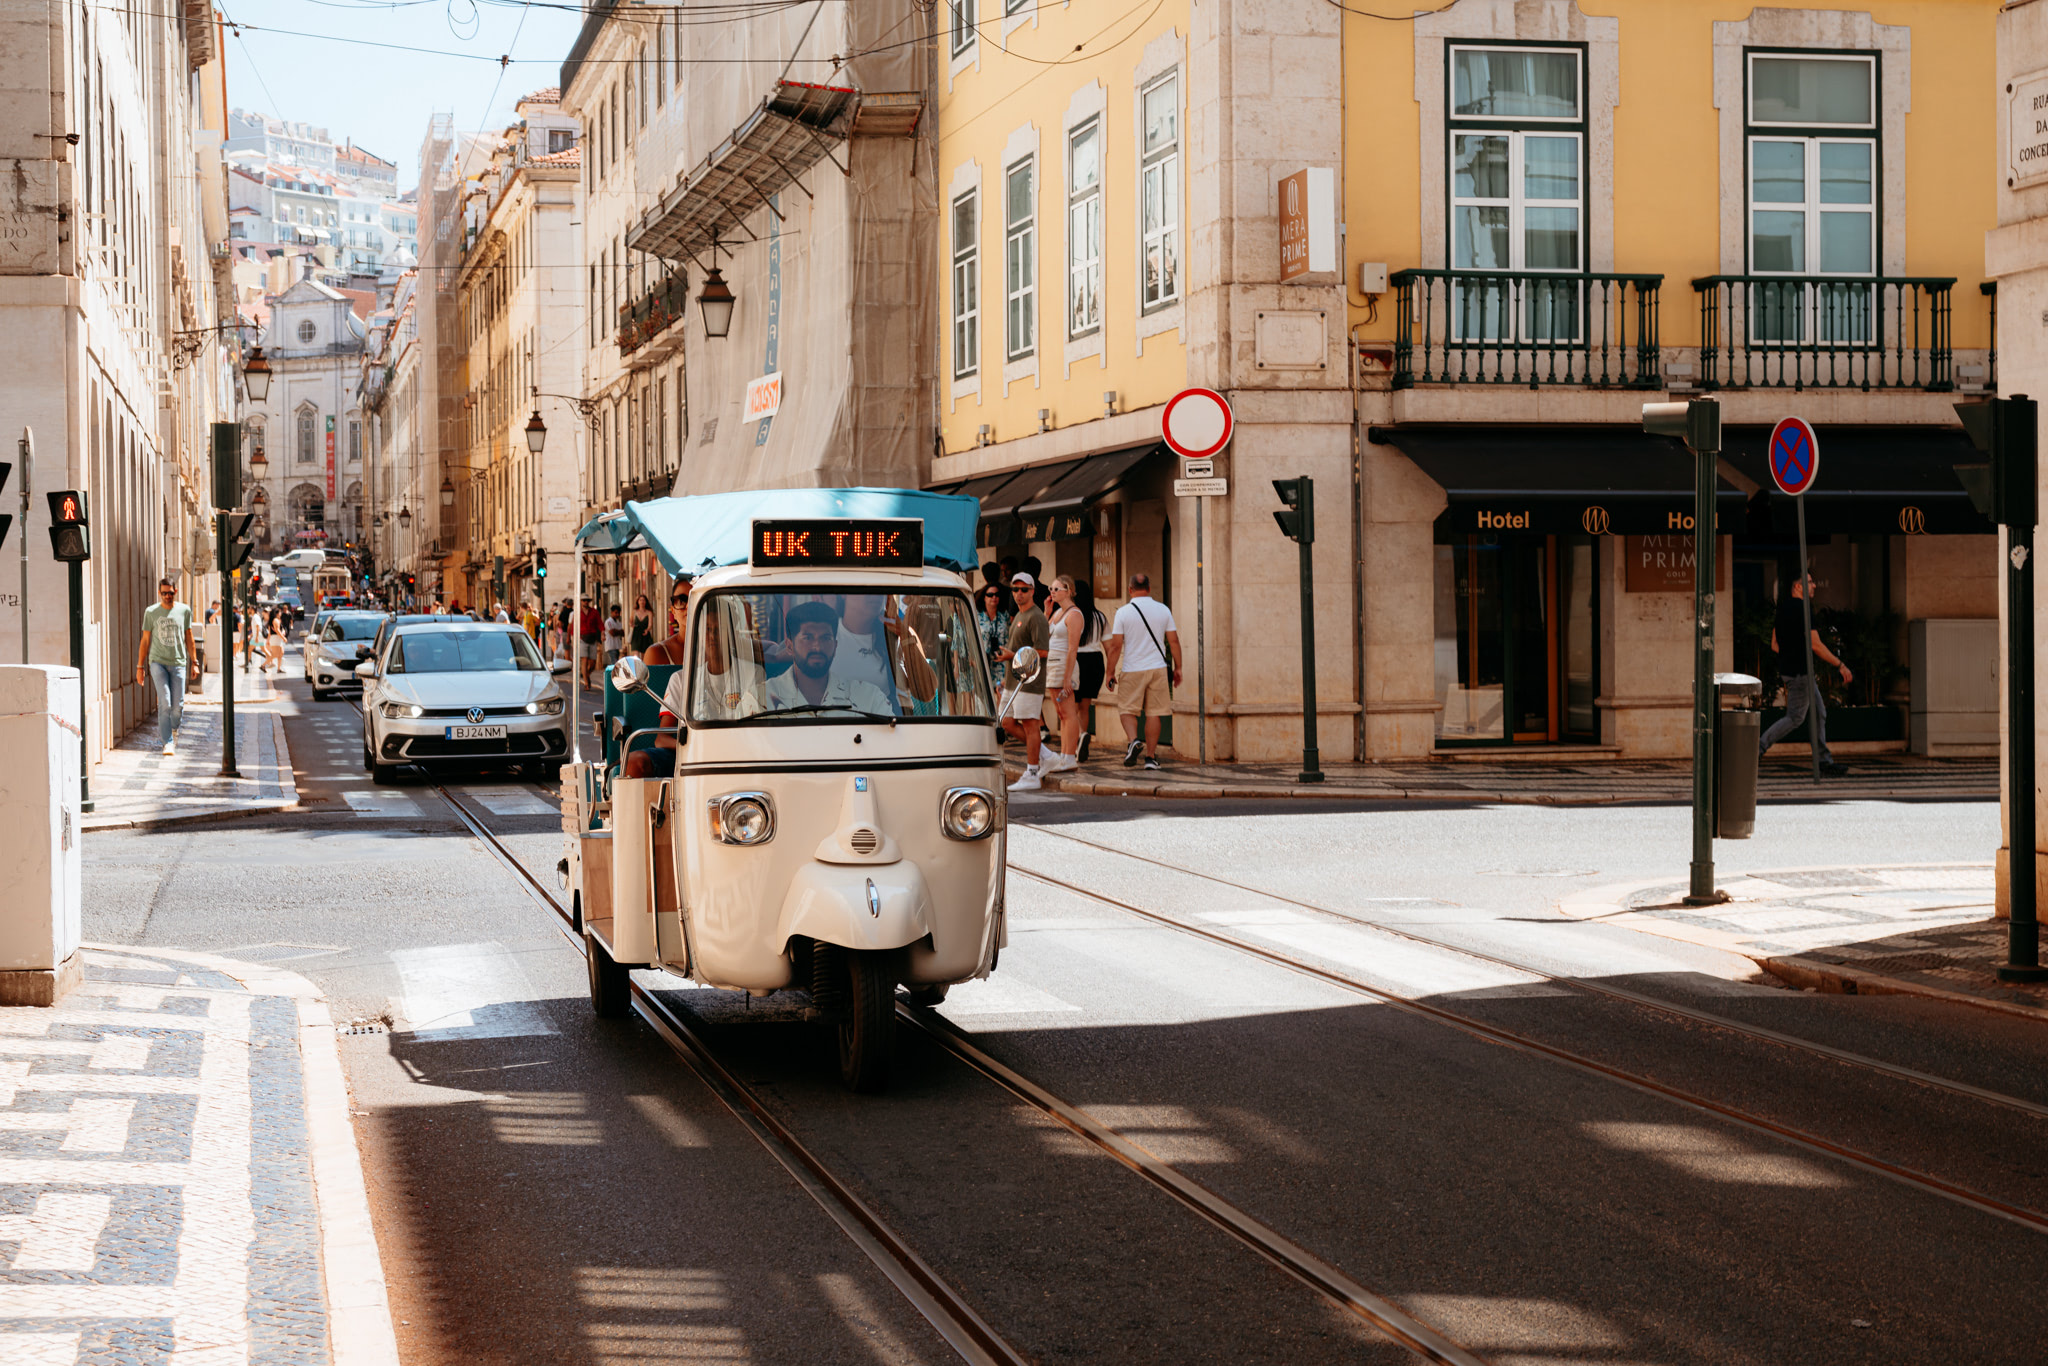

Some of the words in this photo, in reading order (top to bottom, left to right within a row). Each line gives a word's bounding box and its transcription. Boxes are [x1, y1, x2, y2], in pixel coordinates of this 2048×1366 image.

[2033, 94, 2048, 111] RUA
[1282, 217, 1306, 243] MERA
[1282, 238, 1307, 265] PRIME
[1065, 516, 1081, 535] Hotel
[1478, 511, 1530, 529] Hotel
[1668, 511, 1719, 530] Hol
[763, 531, 810, 557] UK
[830, 531, 900, 557] TUK
[1642, 551, 1697, 569] PRIM
